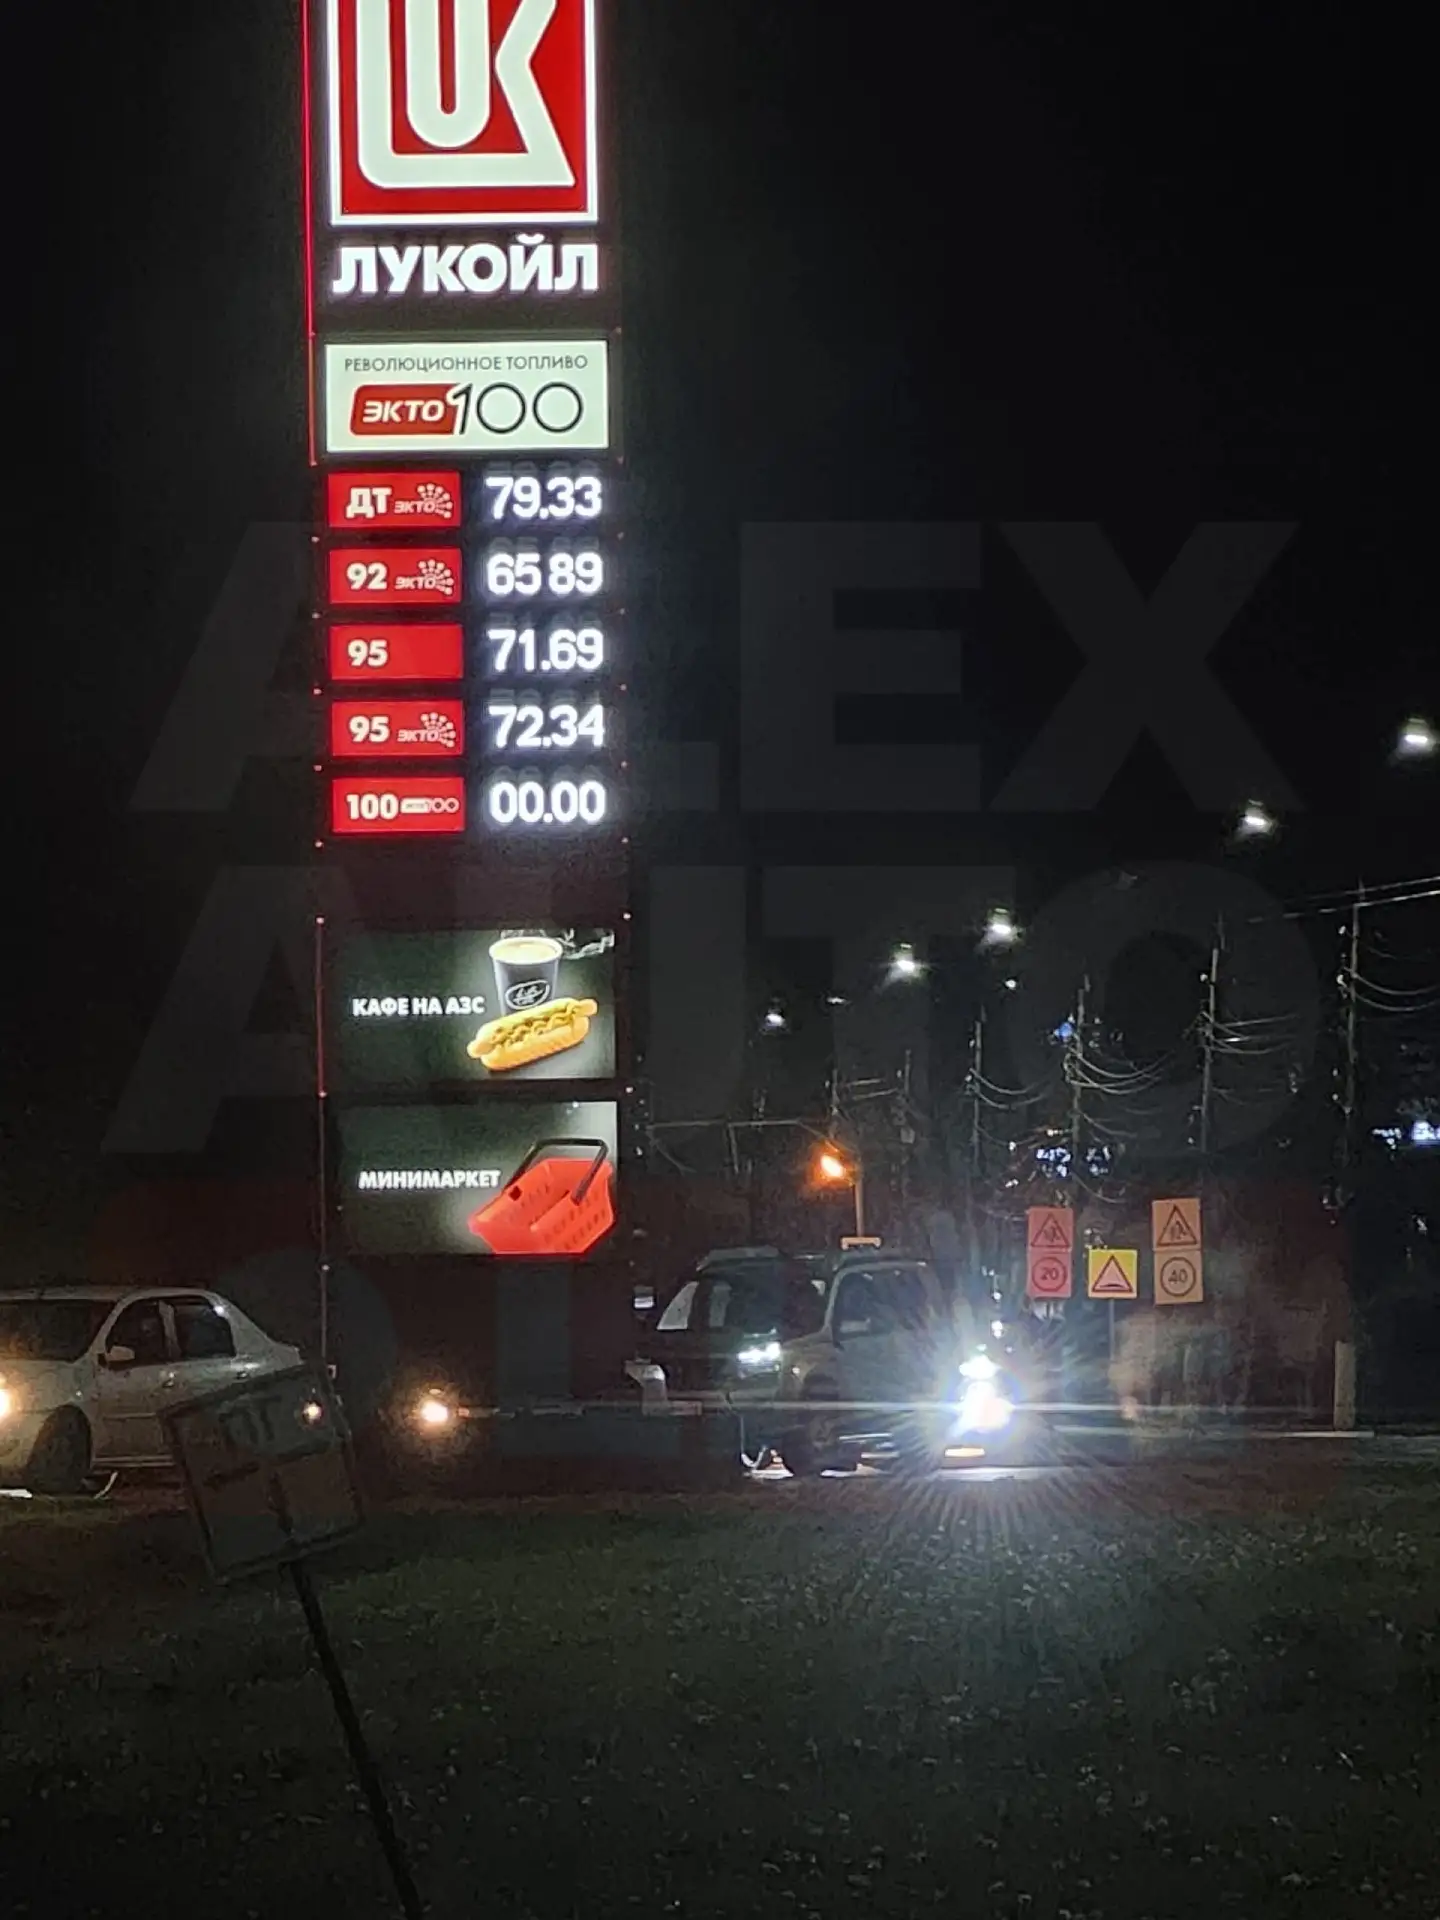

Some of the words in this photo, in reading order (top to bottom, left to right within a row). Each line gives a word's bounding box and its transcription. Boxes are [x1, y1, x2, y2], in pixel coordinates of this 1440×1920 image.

[332, 233, 599, 294] ЛУКОЙЛ
[344, 357, 502, 373] РЕВОЛЮЦИОННОЕ
[506, 355, 589, 370] ТОПЛИВО
[346, 487, 392, 518] ДТ
[394, 501, 437, 514] ЭКТО
[486, 476, 602, 519] 79.33
[346, 562, 388, 590] 92
[395, 576, 437, 589] ЭКТО
[347, 639, 388, 667] 95
[488, 628, 604, 672] 71.69
[349, 715, 390, 743] 95
[397, 729, 438, 742] ЭКТО
[489, 704, 605, 748] 72.34
[346, 793, 399, 820] 100
[489, 780, 606, 824] 00.00
[352, 997, 409, 1016] КАФЕ
[413, 997, 442, 1015] НА
[445, 996, 485, 1014] АЗС
[358, 1169, 501, 1190] МИНИМАРКЕТ
[1041, 1264, 1060, 1282] 20
[1168, 1269, 1188, 1285] 40
